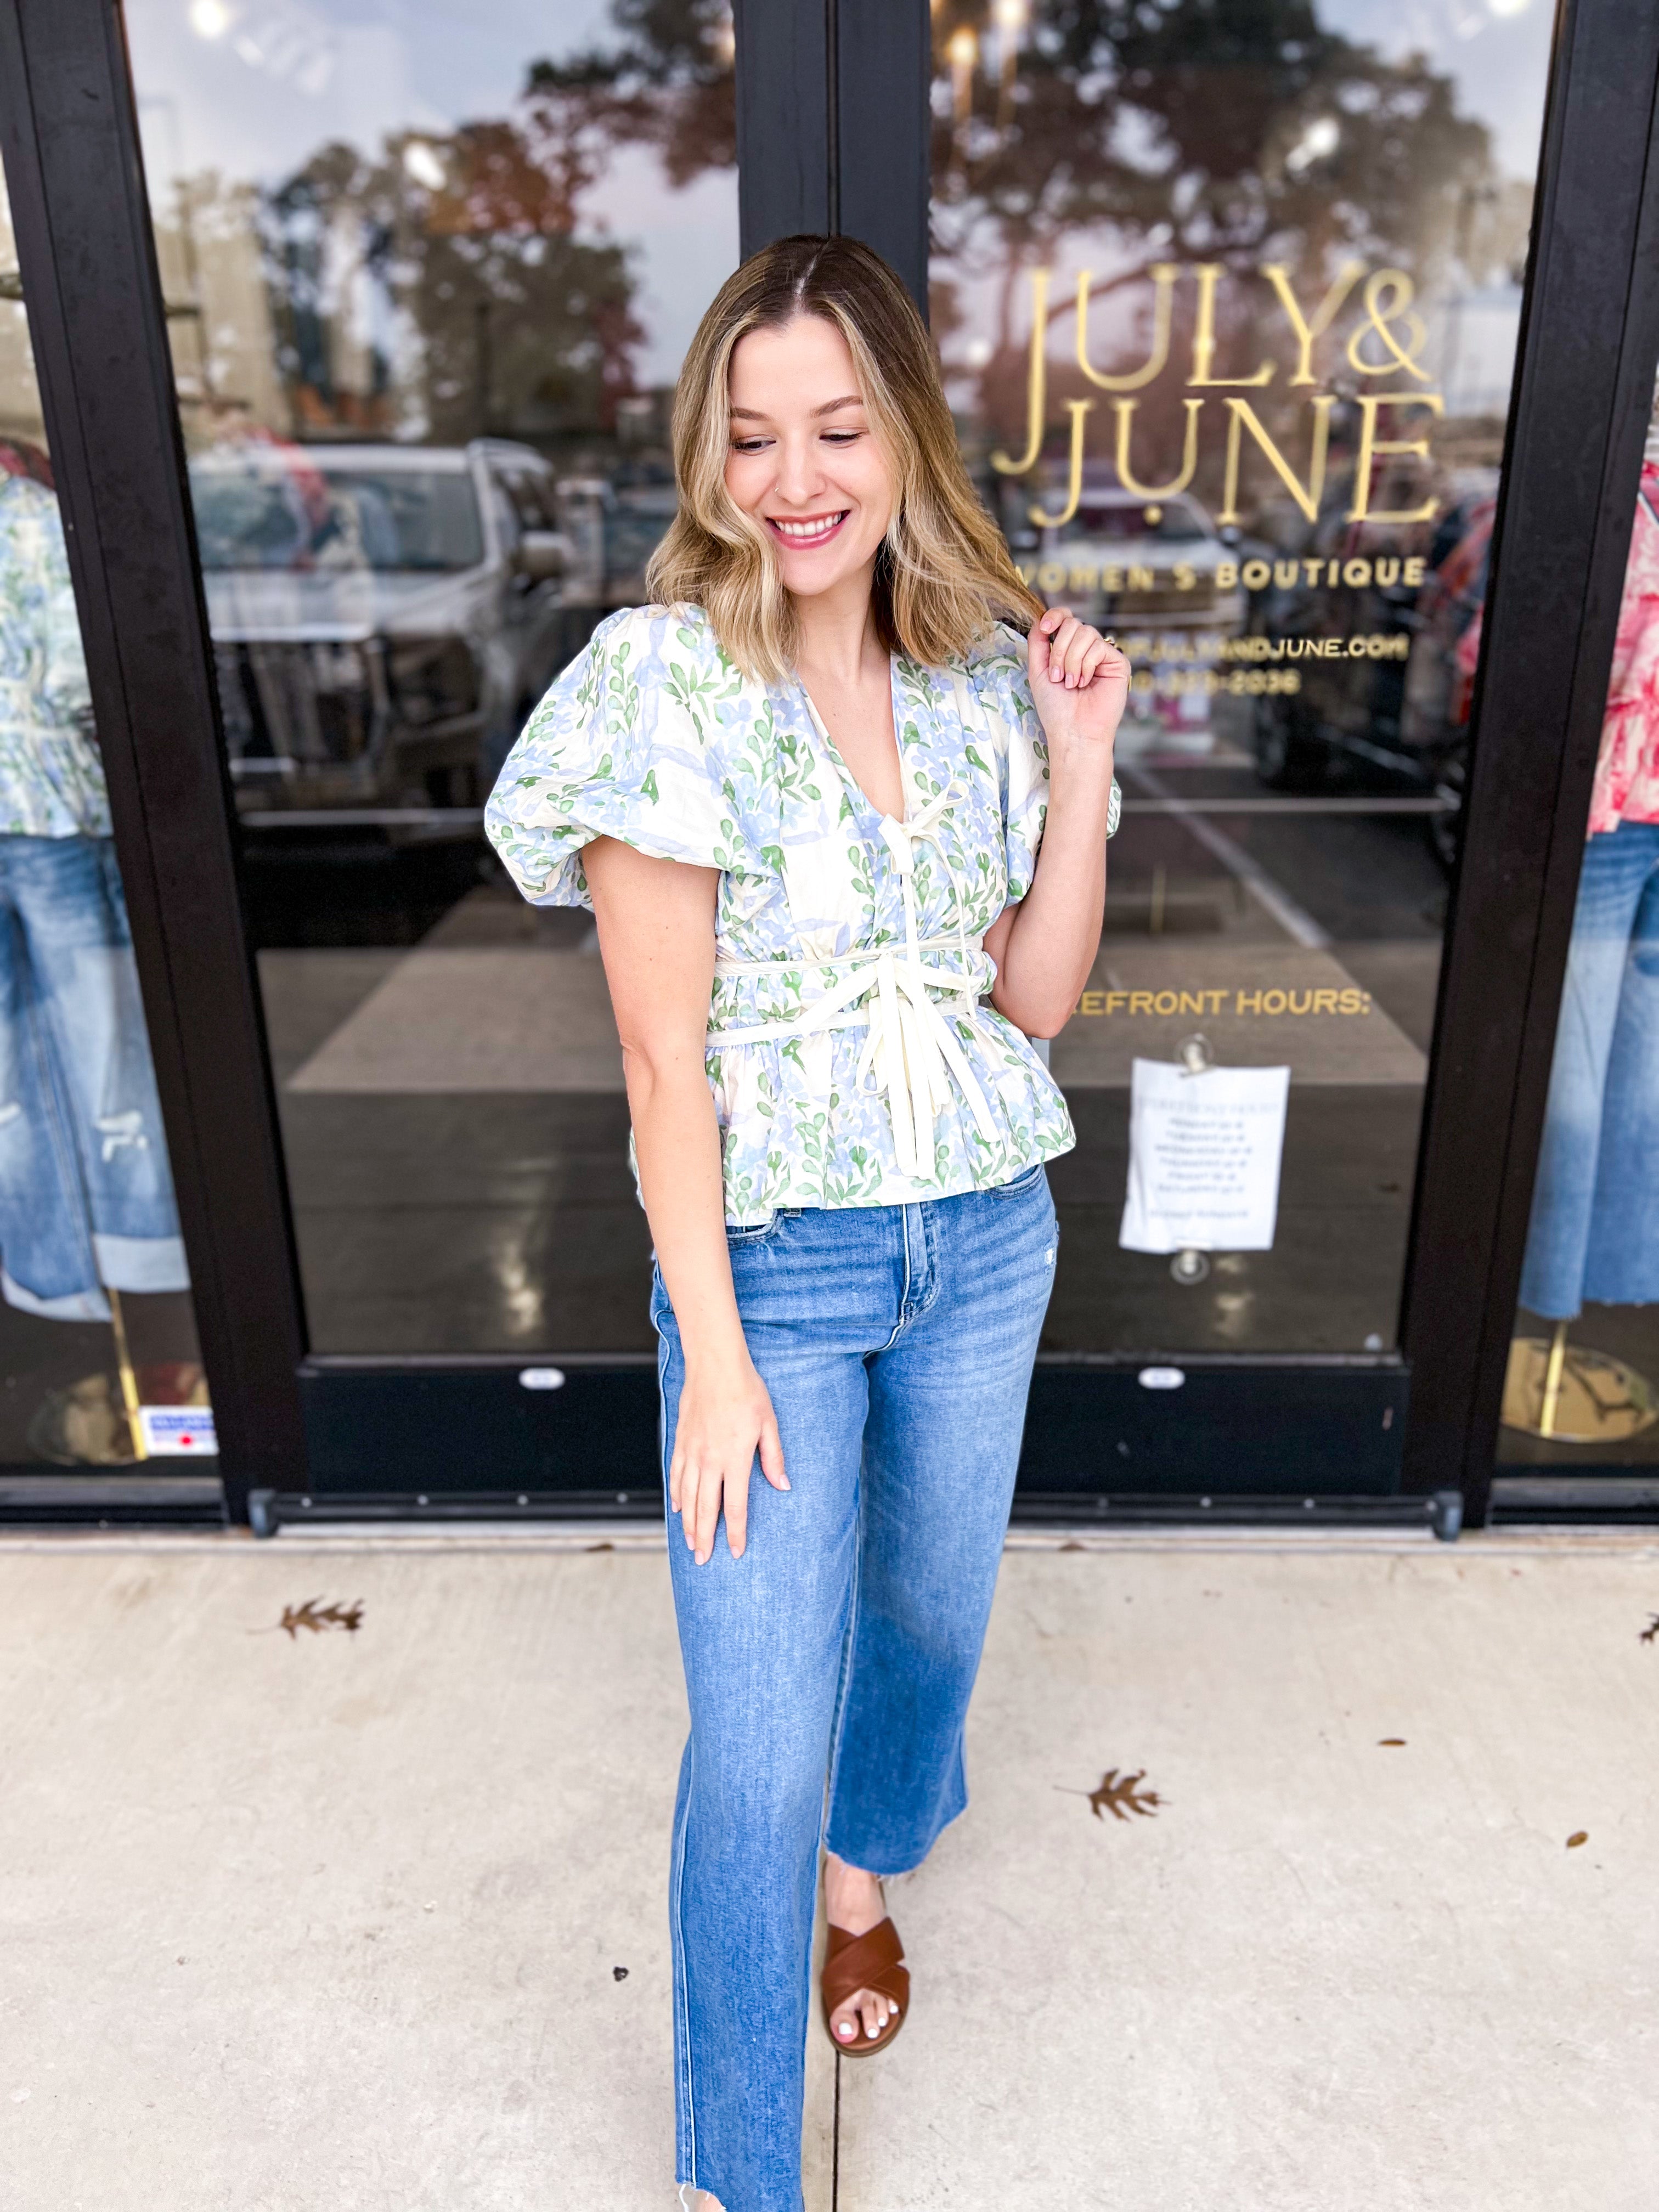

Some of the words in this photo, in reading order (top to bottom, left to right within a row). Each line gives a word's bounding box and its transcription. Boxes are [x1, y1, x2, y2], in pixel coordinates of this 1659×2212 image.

[1027, 392, 1445, 529] JUNE
[1214, 556, 1426, 589] BOUTIQUE
[1073, 990, 1229, 1016] EFRONT
[1235, 988, 1372, 1015] HOURS:
